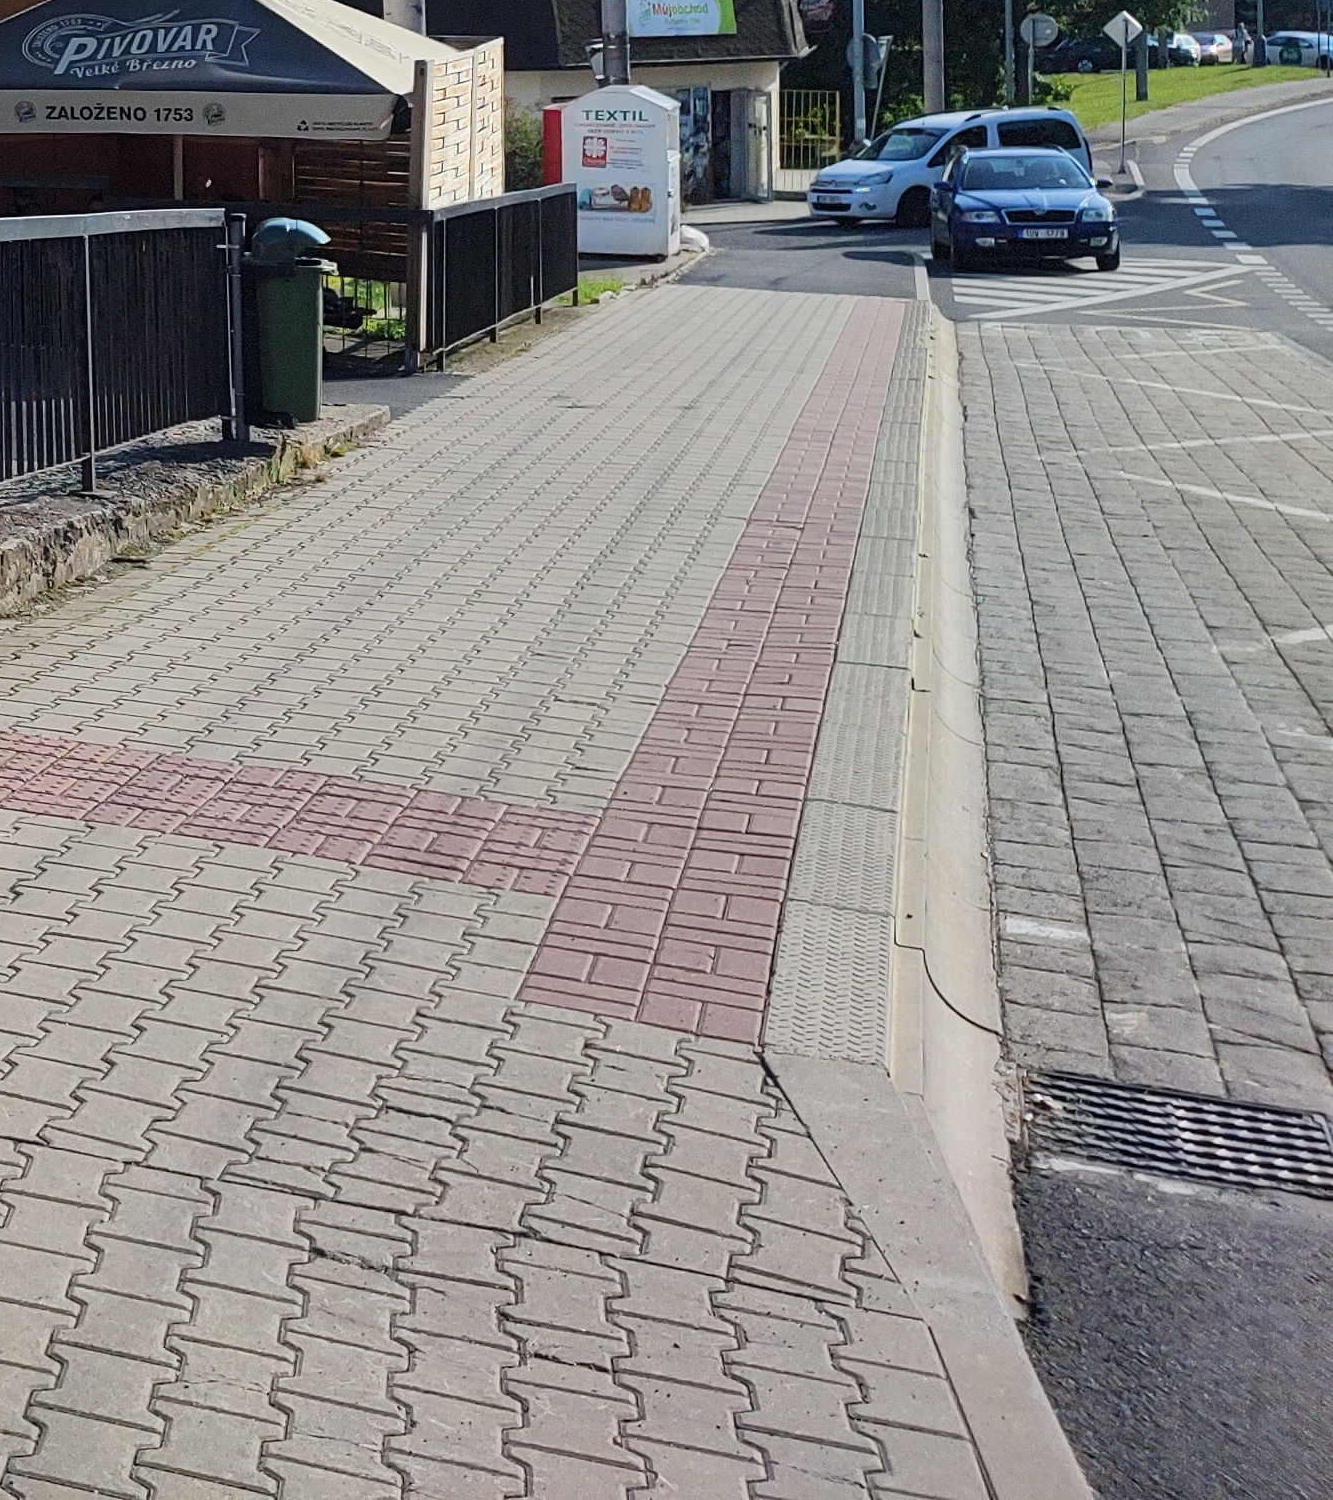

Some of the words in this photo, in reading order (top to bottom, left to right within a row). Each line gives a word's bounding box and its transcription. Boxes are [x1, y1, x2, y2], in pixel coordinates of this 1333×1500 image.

[54, 23, 218, 75] PIVOVAR
[70, 61, 120, 78] Velké
[126, 58, 198, 73] Březno
[46, 104, 147, 122] ZALOŽENO
[154, 108, 194, 122] 1753
[582, 110, 649, 122] TEXTIL
